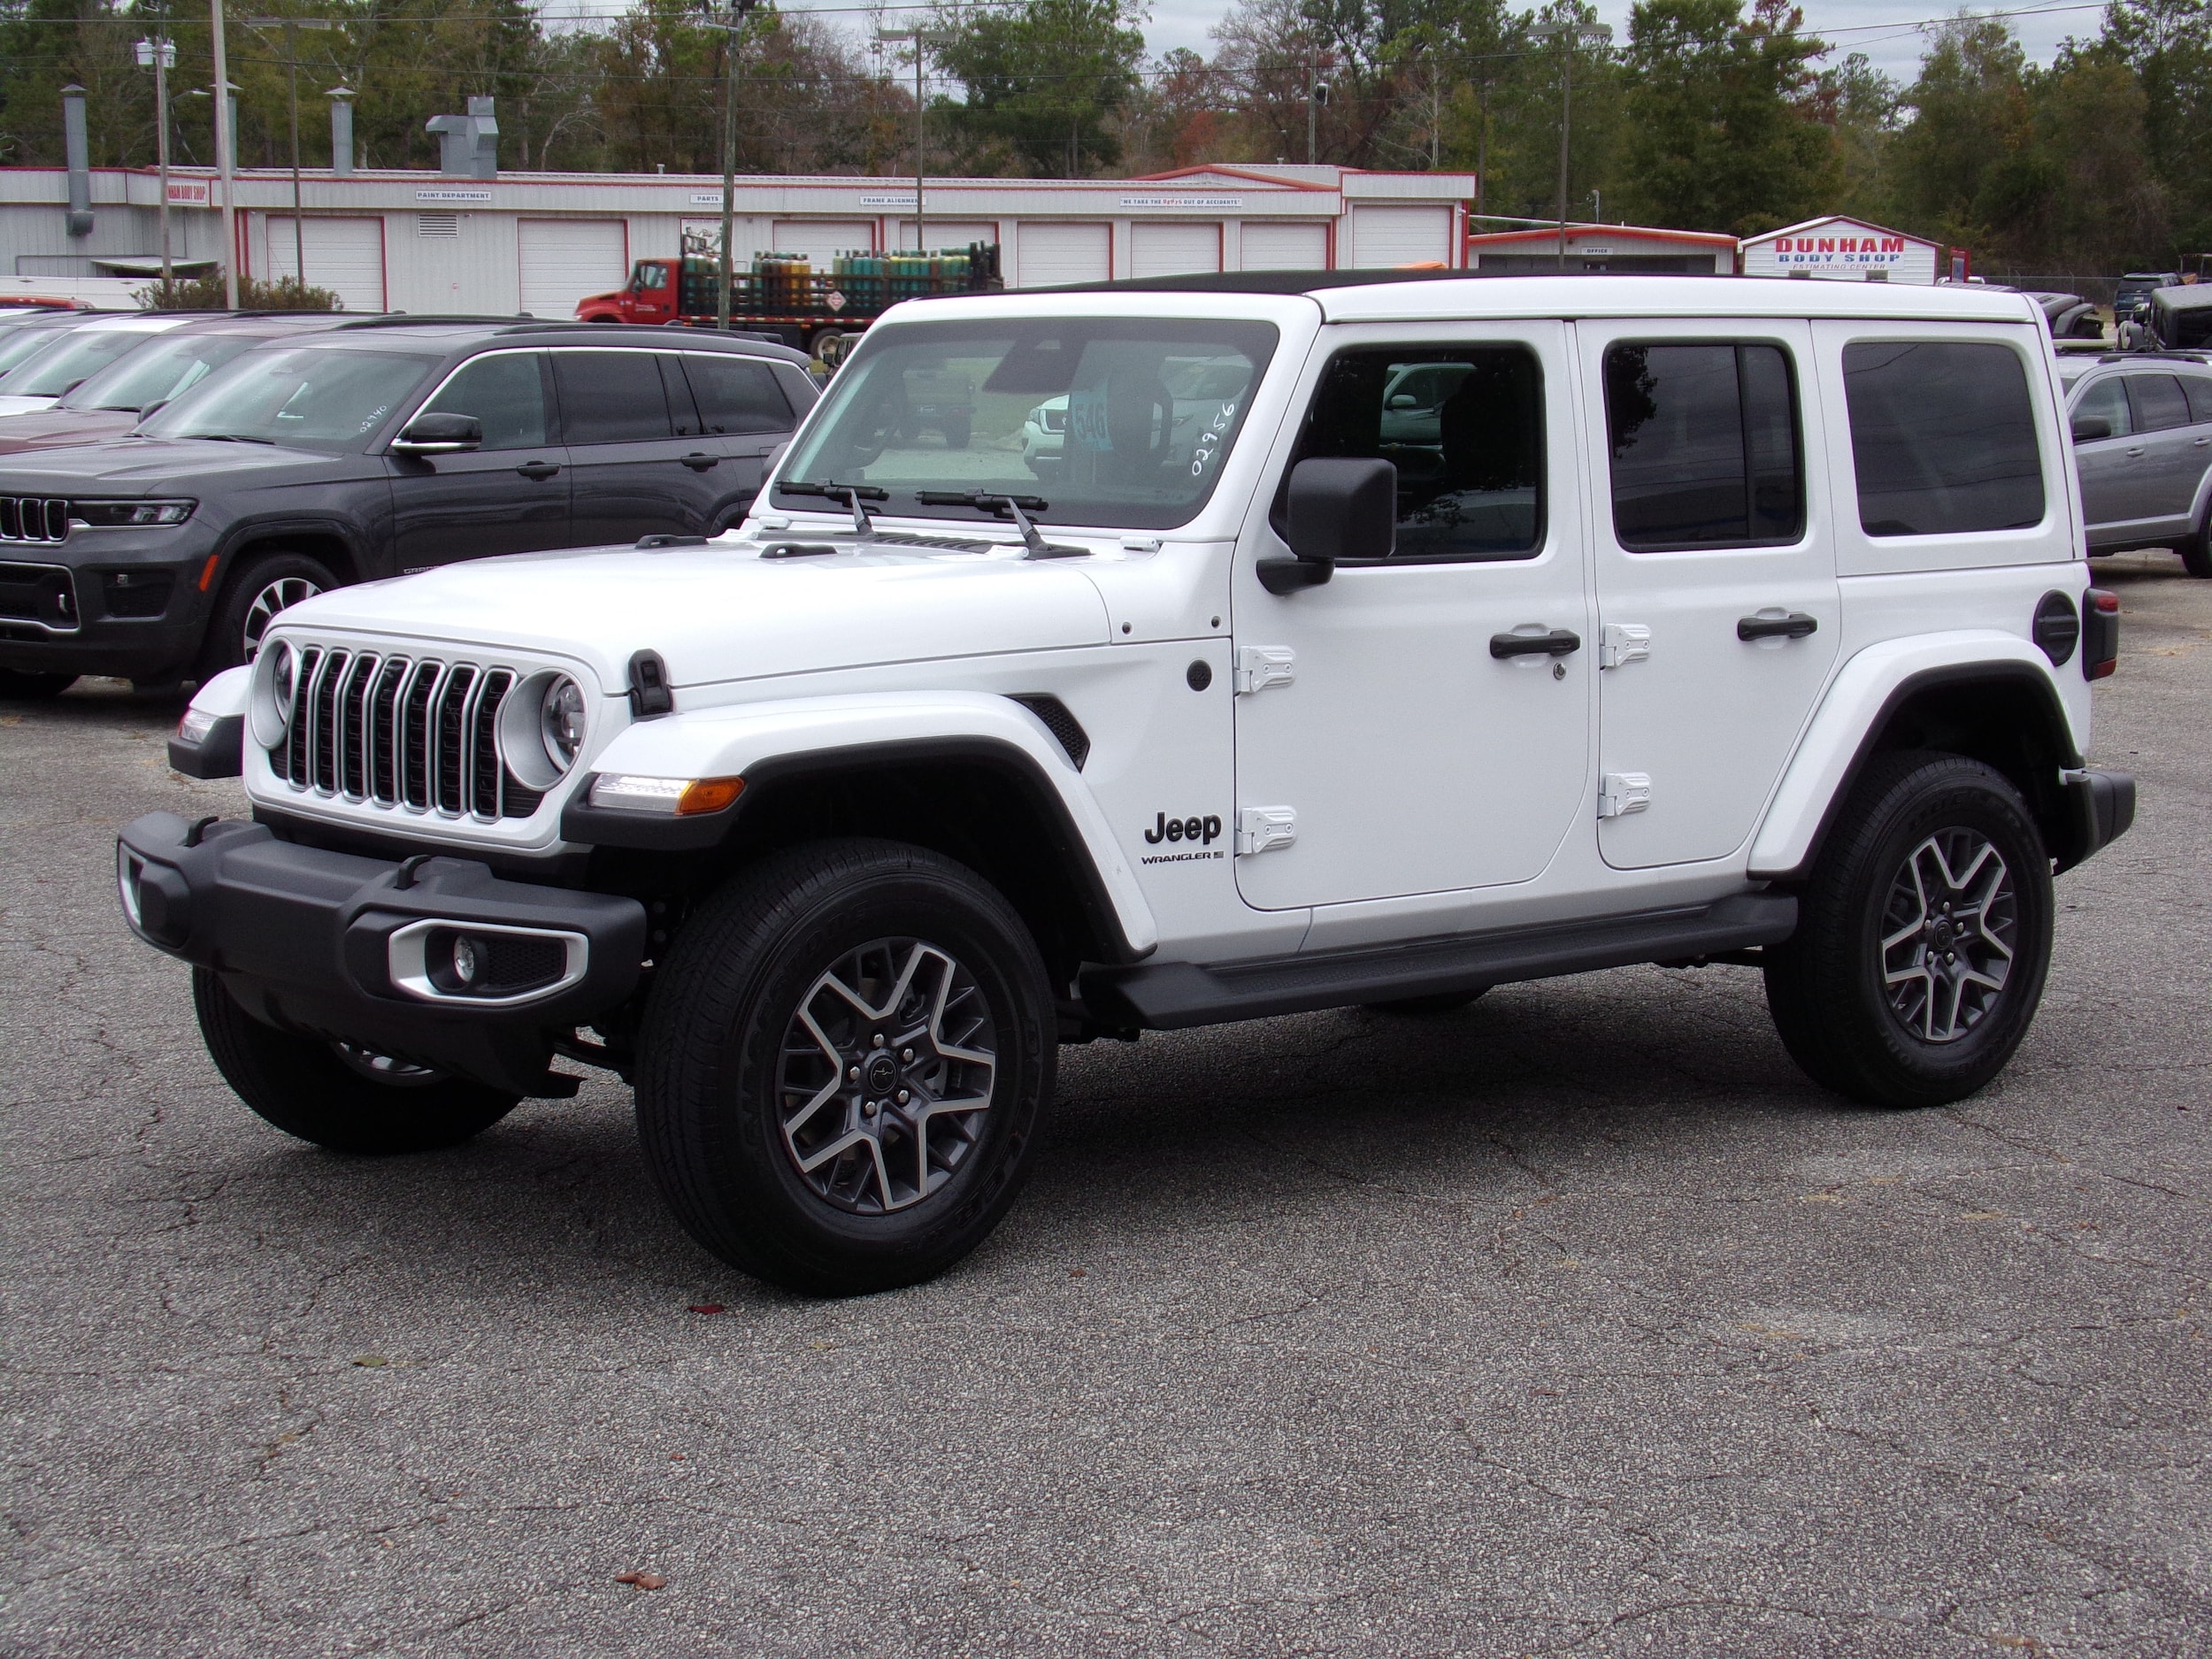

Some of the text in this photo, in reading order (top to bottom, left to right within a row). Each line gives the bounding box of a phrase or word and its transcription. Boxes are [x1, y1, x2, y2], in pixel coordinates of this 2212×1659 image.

[1775, 237, 1905, 252] DUNHAM
[1778, 254, 1901, 263] BODY SHOP
[1191, 402, 1235, 475] 02956
[1144, 811, 1222, 845] Jeep
[1141, 851, 1211, 865] WRANGLER
